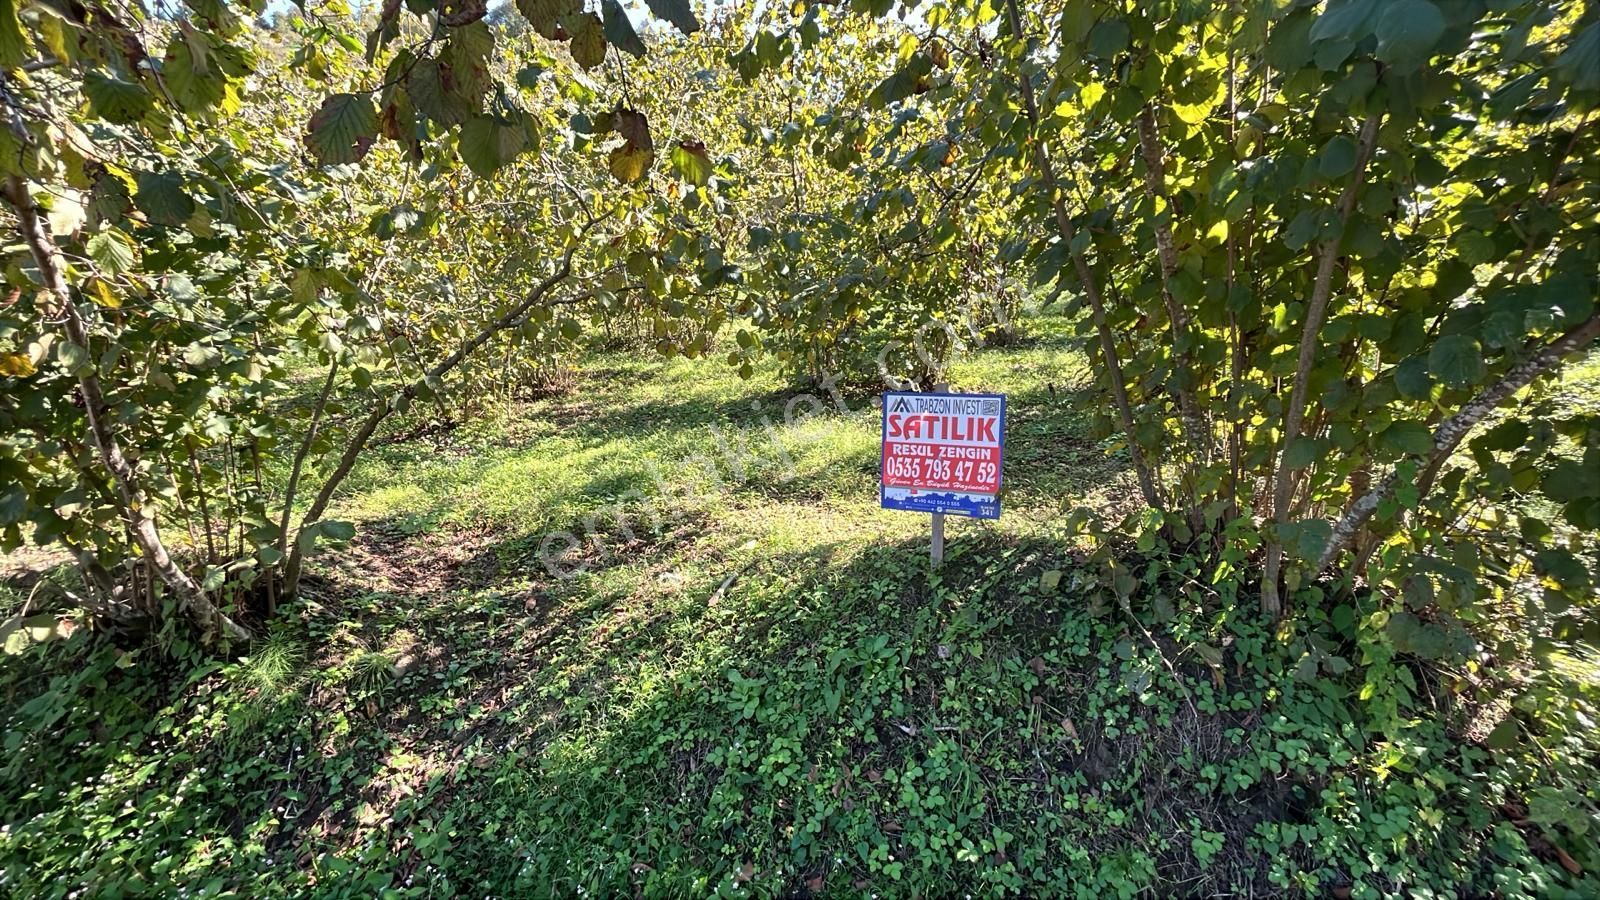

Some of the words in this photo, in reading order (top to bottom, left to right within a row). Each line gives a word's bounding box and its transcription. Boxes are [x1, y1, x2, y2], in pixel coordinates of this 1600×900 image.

[915, 398, 950, 414] TRABZON
[952, 400, 982, 415] INVEST
[888, 414, 996, 442] SATILIK
[893, 444, 934, 456] RESUL
[886, 457, 920, 478] 0535
[924, 459, 951, 480] 793
[954, 461, 973, 481] 47
[977, 463, 996, 484] 52
